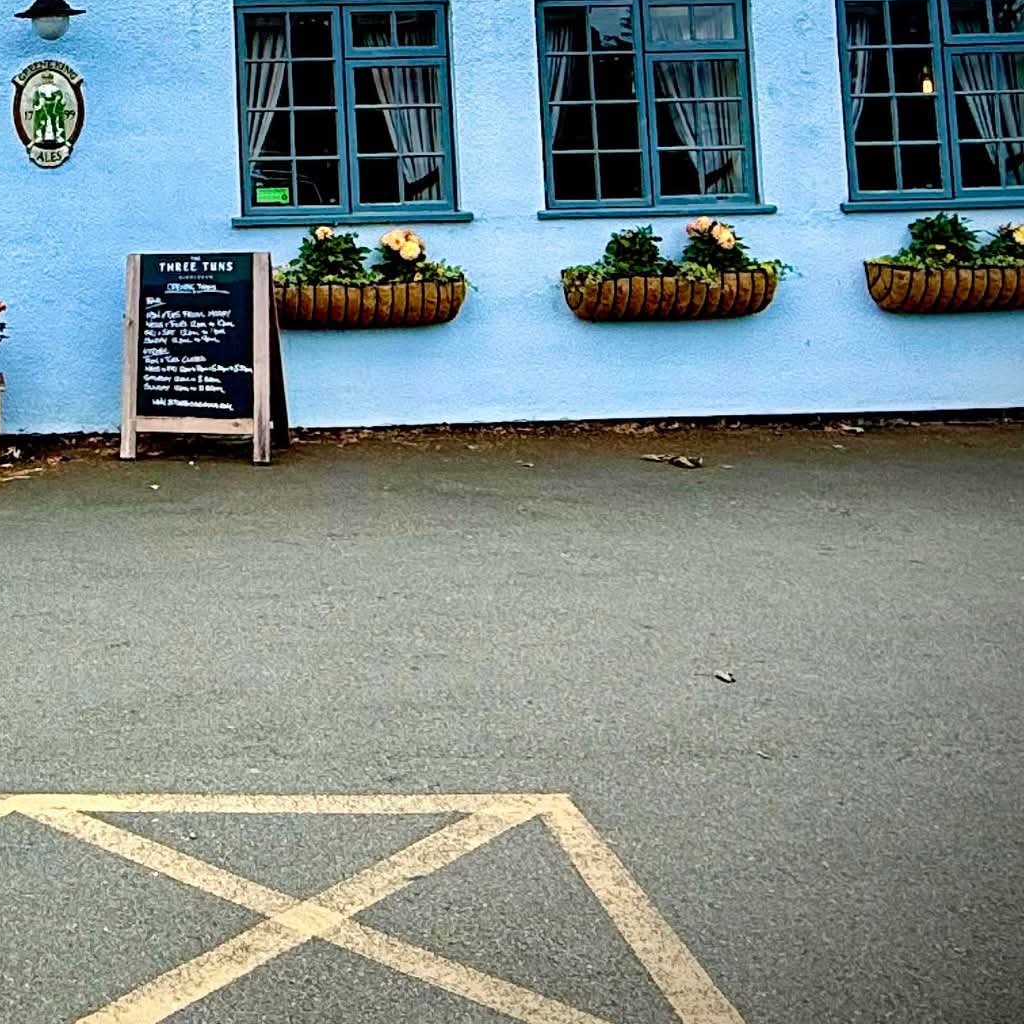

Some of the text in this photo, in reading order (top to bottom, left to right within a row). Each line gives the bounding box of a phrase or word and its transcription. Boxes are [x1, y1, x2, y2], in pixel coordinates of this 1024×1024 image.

[36, 151, 63, 163] ALES
[159, 261, 234, 273] THREE TUNS
